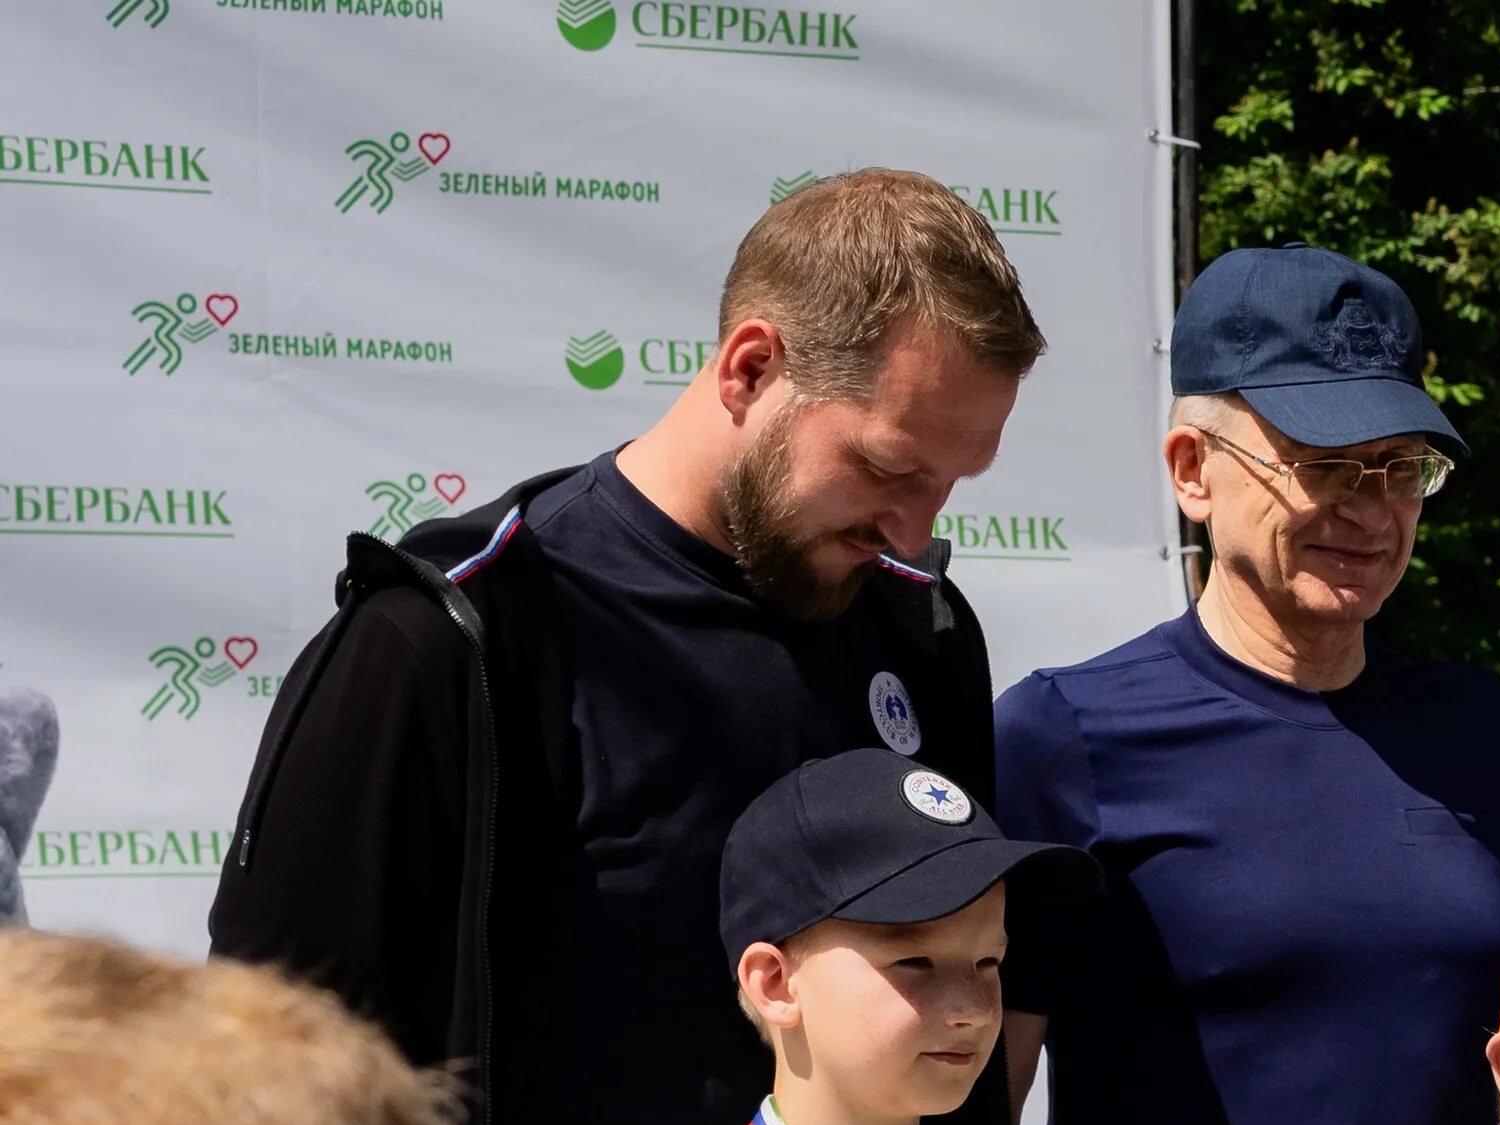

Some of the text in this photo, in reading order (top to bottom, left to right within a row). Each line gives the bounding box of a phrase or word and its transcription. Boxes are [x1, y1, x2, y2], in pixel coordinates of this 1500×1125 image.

[631, 1, 860, 49] СБЕРБАНК
[439, 172, 660, 203] ЗЕЛЕНЫЙ МАРАФОН
[227, 332, 453, 363] ЗЕЛЕНЫЙ МАРАФОН
[19, 829, 233, 868] БЕРБАН
